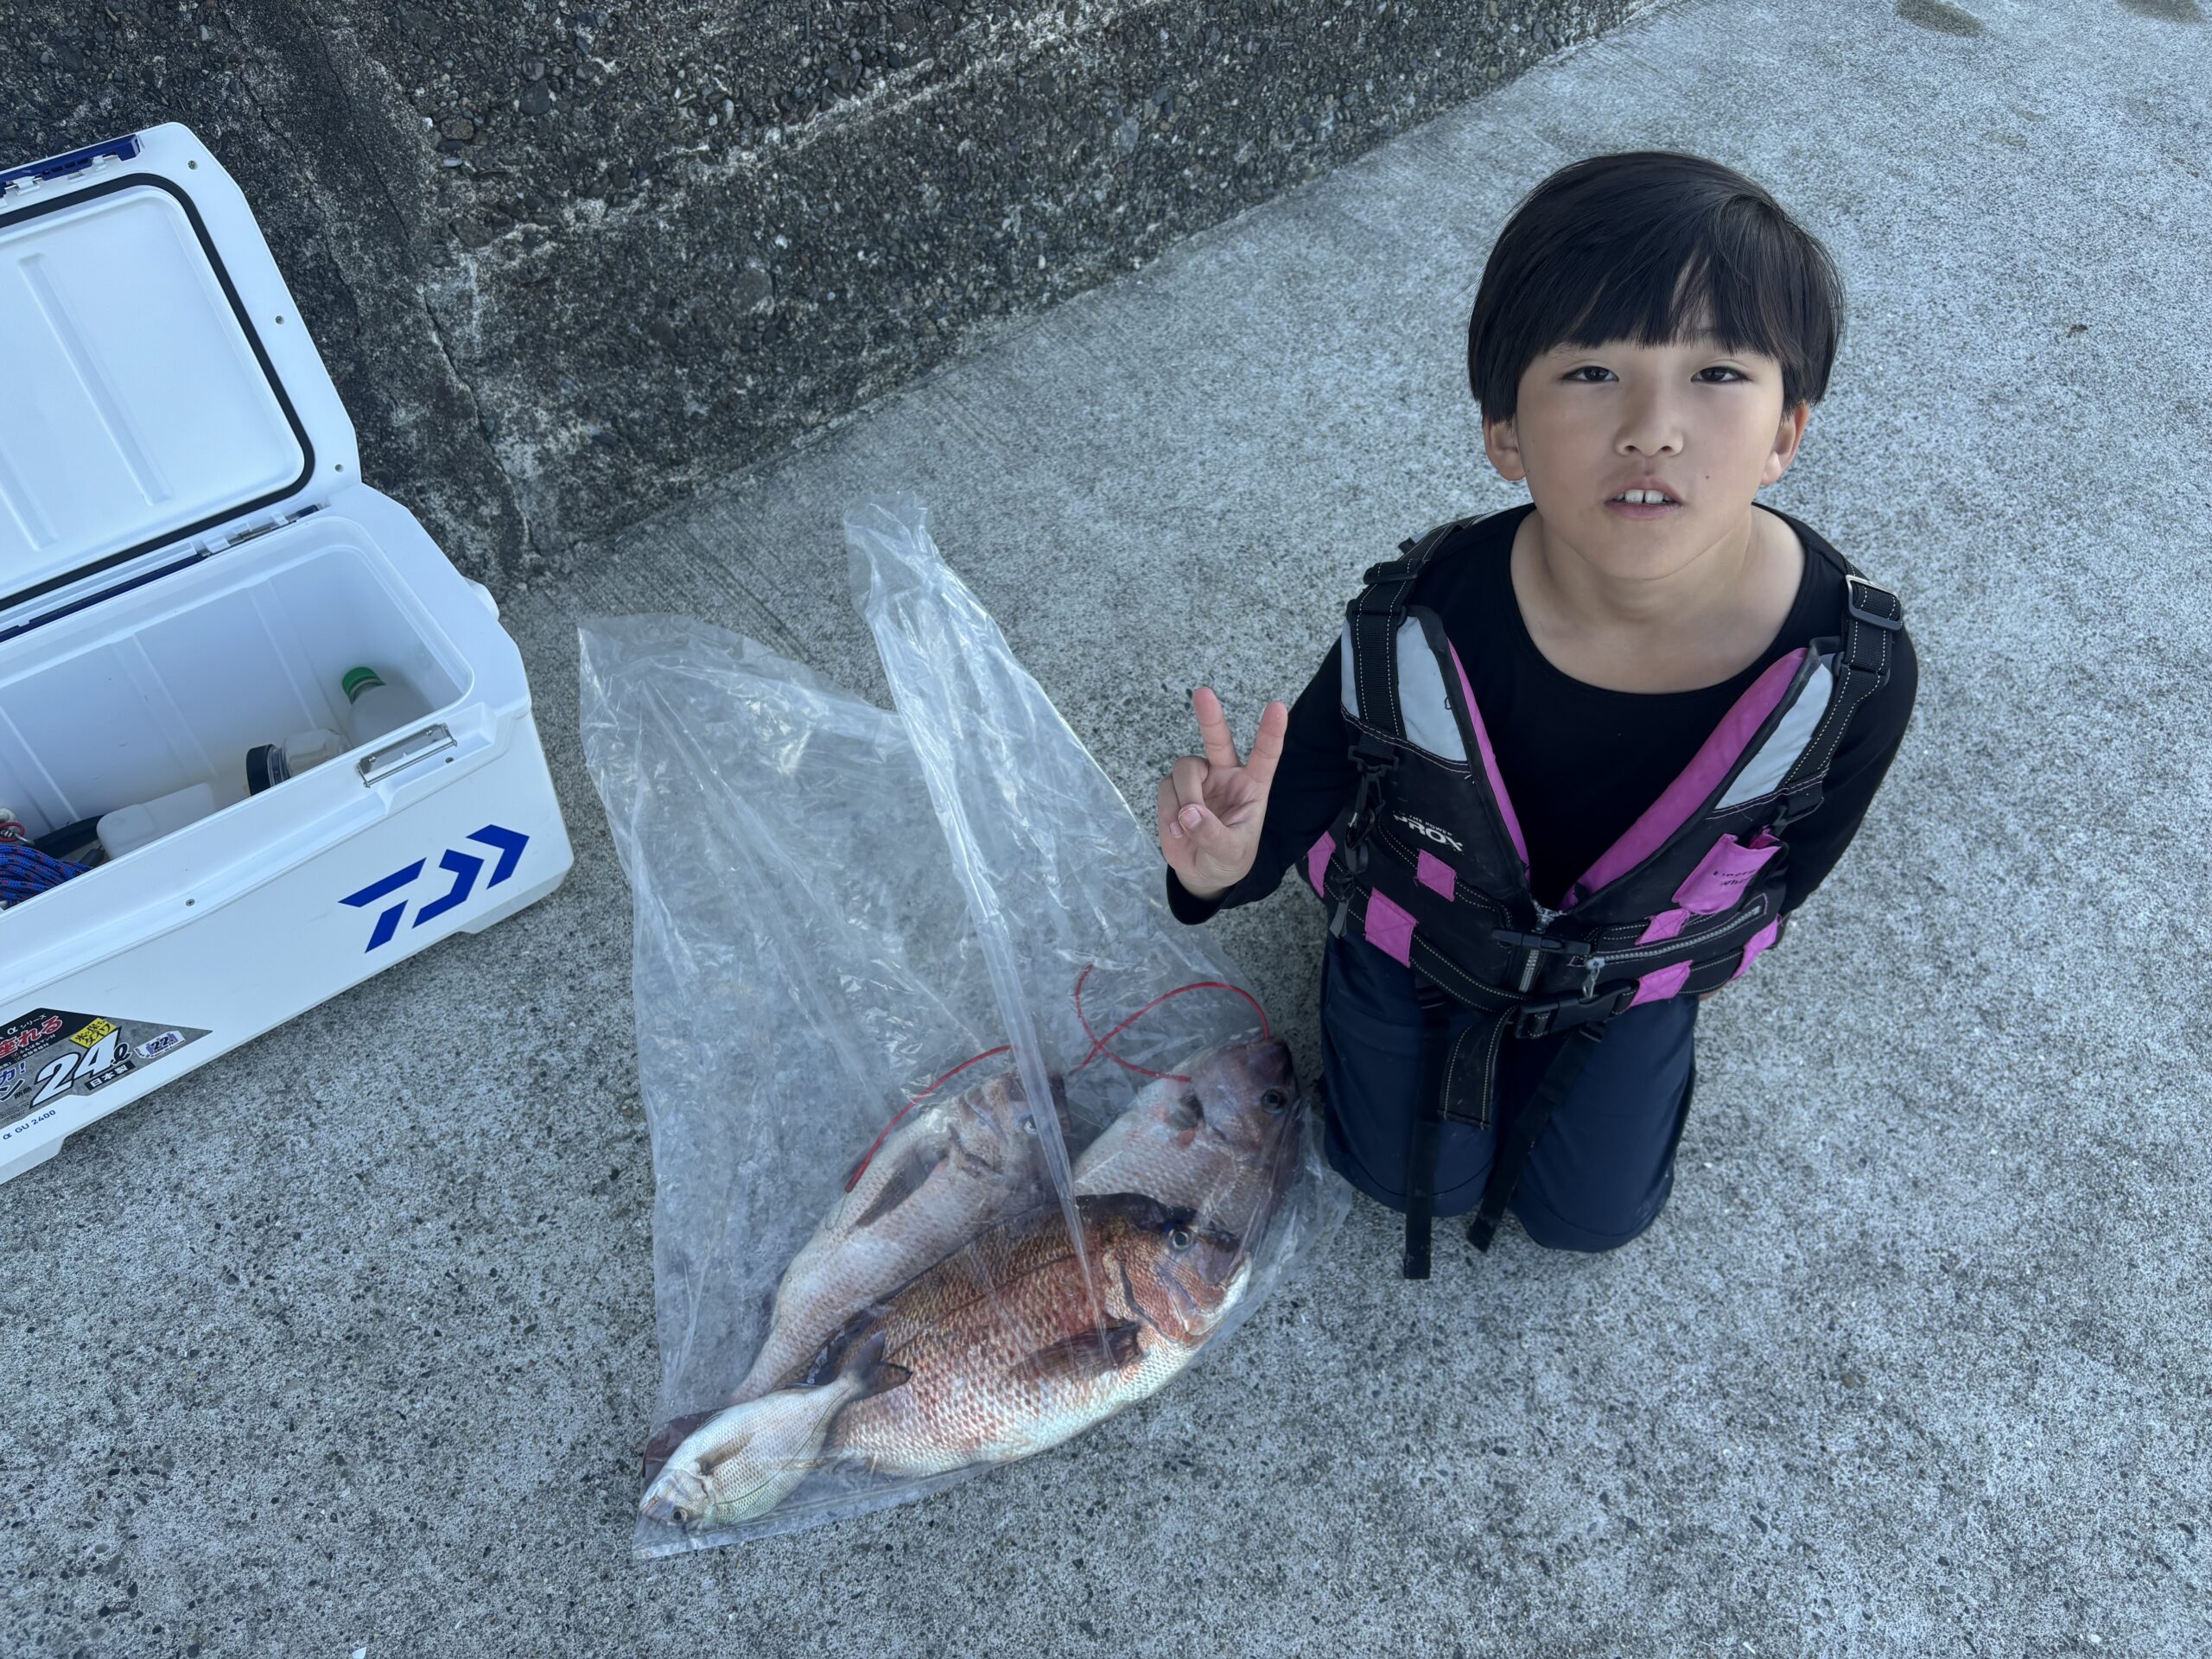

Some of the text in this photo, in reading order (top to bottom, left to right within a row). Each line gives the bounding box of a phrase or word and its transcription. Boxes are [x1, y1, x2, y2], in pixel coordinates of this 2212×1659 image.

[89, 1065, 129, 1088] 日本製
[15, 1123, 29, 1134] GU
[31, 1109, 56, 1125] 2400
